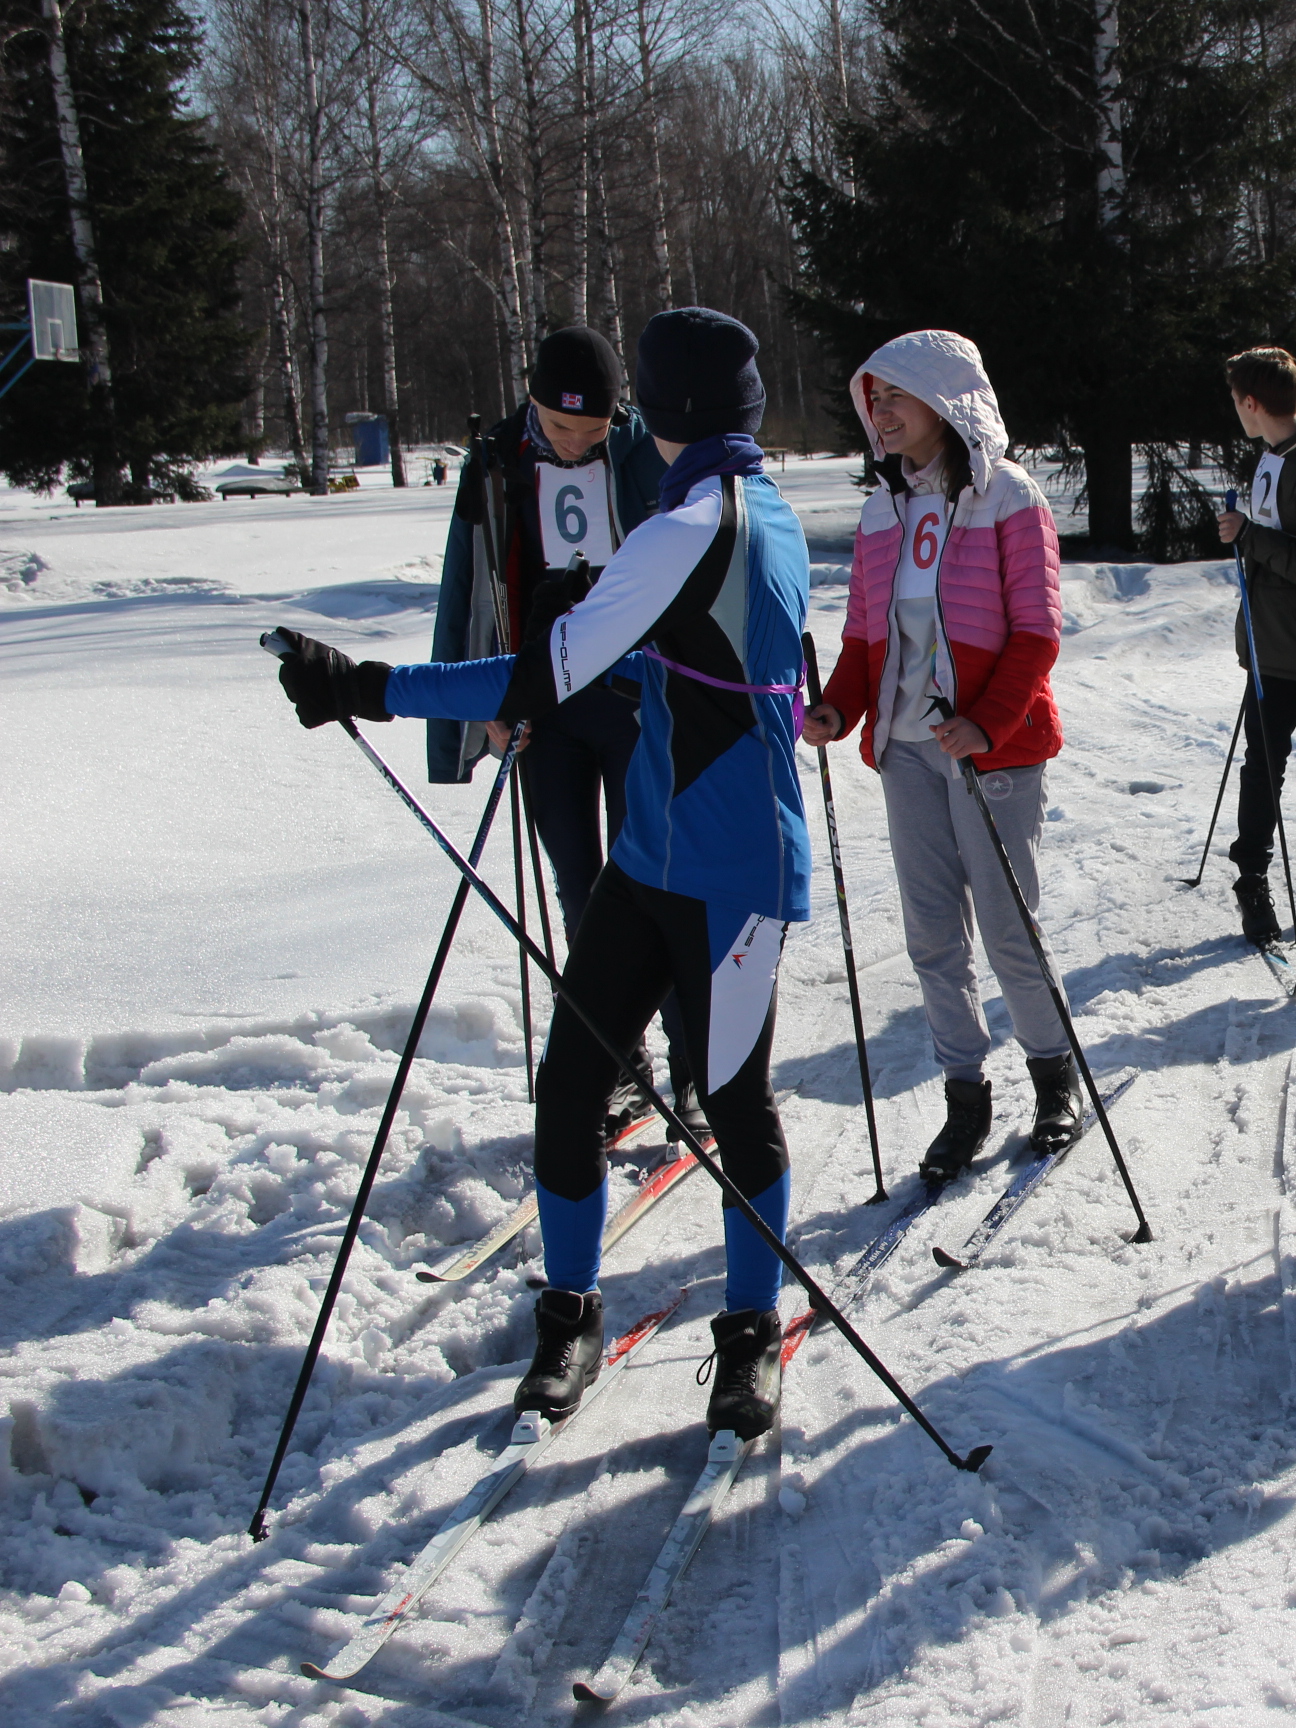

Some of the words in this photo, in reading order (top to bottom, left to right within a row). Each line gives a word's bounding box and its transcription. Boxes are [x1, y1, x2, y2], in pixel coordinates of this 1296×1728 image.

[586, 468, 596, 483] 5
[1257, 470, 1272, 518] 2
[555, 485, 588, 544] 6
[912, 511, 940, 570] 6
[560, 621, 572, 692] SP-OLIMP
